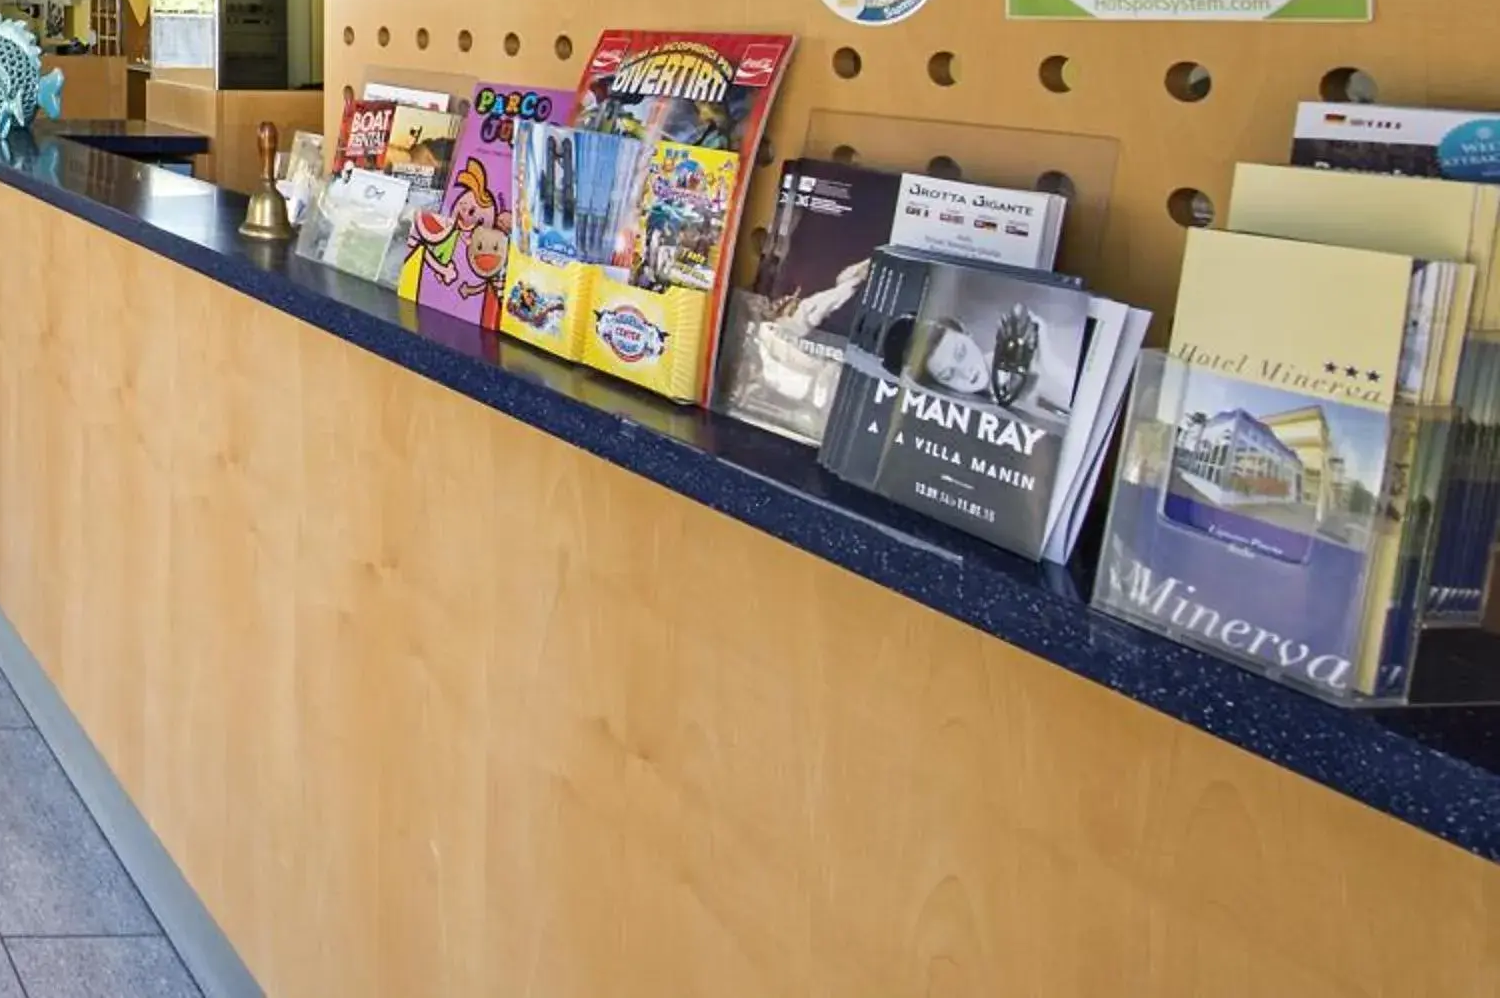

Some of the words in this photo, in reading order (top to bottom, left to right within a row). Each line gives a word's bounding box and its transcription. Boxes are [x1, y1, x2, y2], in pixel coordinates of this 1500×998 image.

[351, 109, 393, 133] BOAT
[475, 87, 553, 123] PARCO
[1178, 343, 1247, 374] Hotel
[1260, 359, 1381, 403] Minerva
[901, 388, 971, 434] MAN
[977, 411, 1047, 456] RAY
[915, 436, 961, 466] VILLA
[971, 457, 1036, 491] MANIN
[1128, 560, 1352, 689] Minerva
